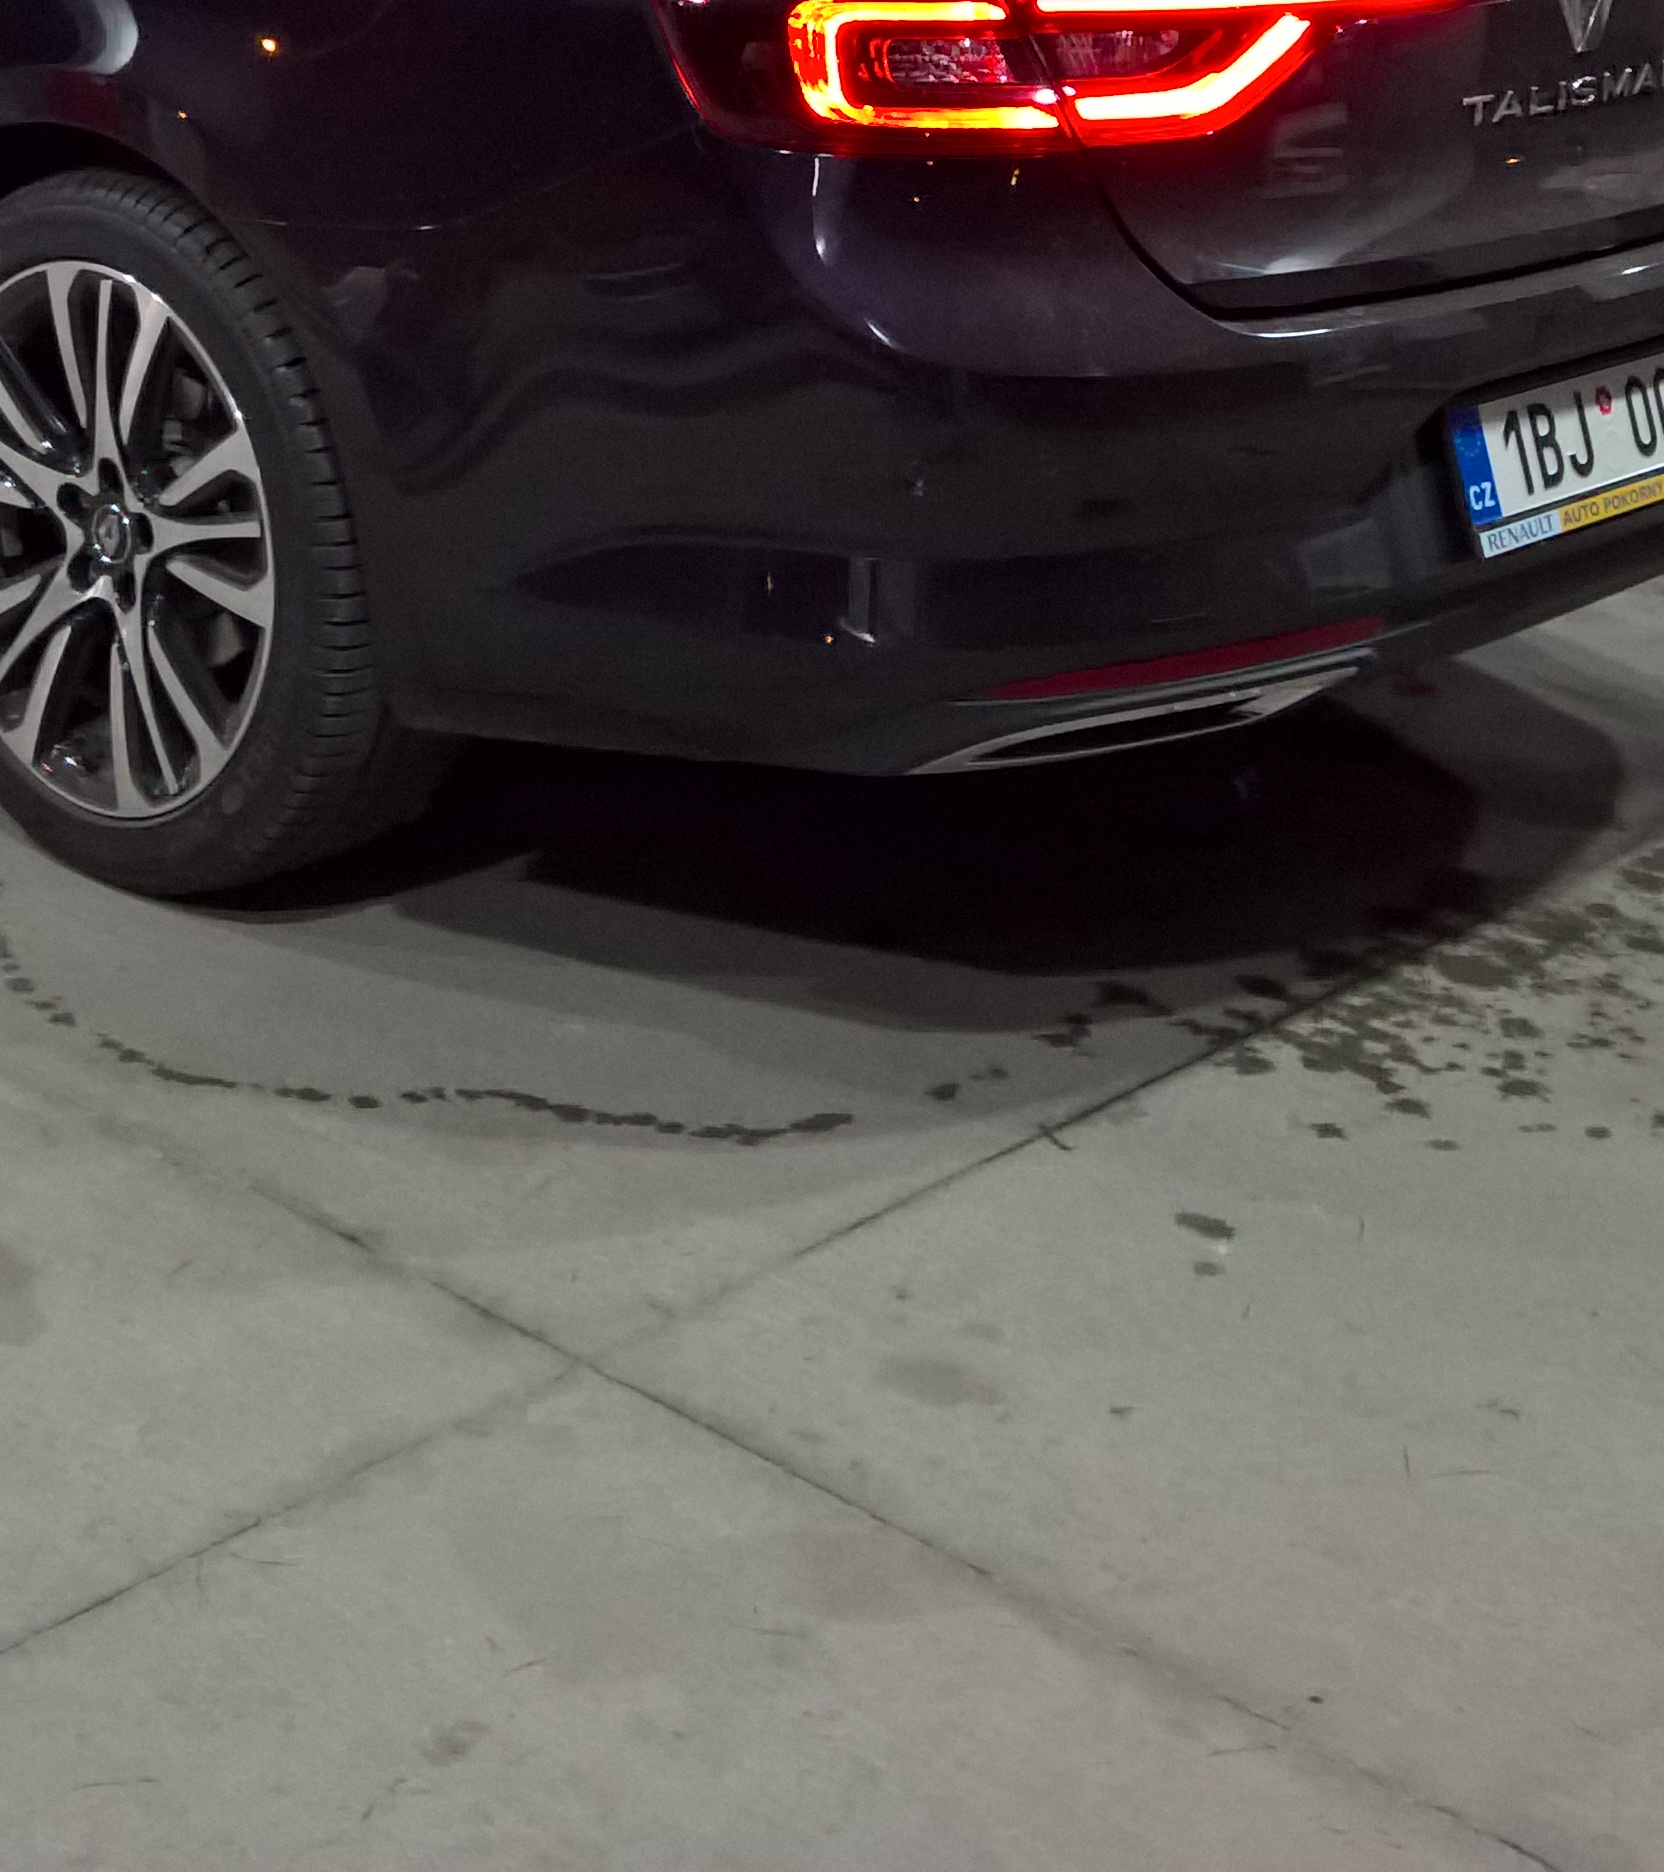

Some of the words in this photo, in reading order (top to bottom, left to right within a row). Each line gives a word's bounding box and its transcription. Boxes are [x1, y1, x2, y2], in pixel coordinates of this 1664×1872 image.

[1502, 389, 1596, 497] 1BJ
[1468, 481, 1497, 511] CZ
[1486, 513, 1554, 553] RENAULT
[1562, 501, 1600, 527] AUTO
